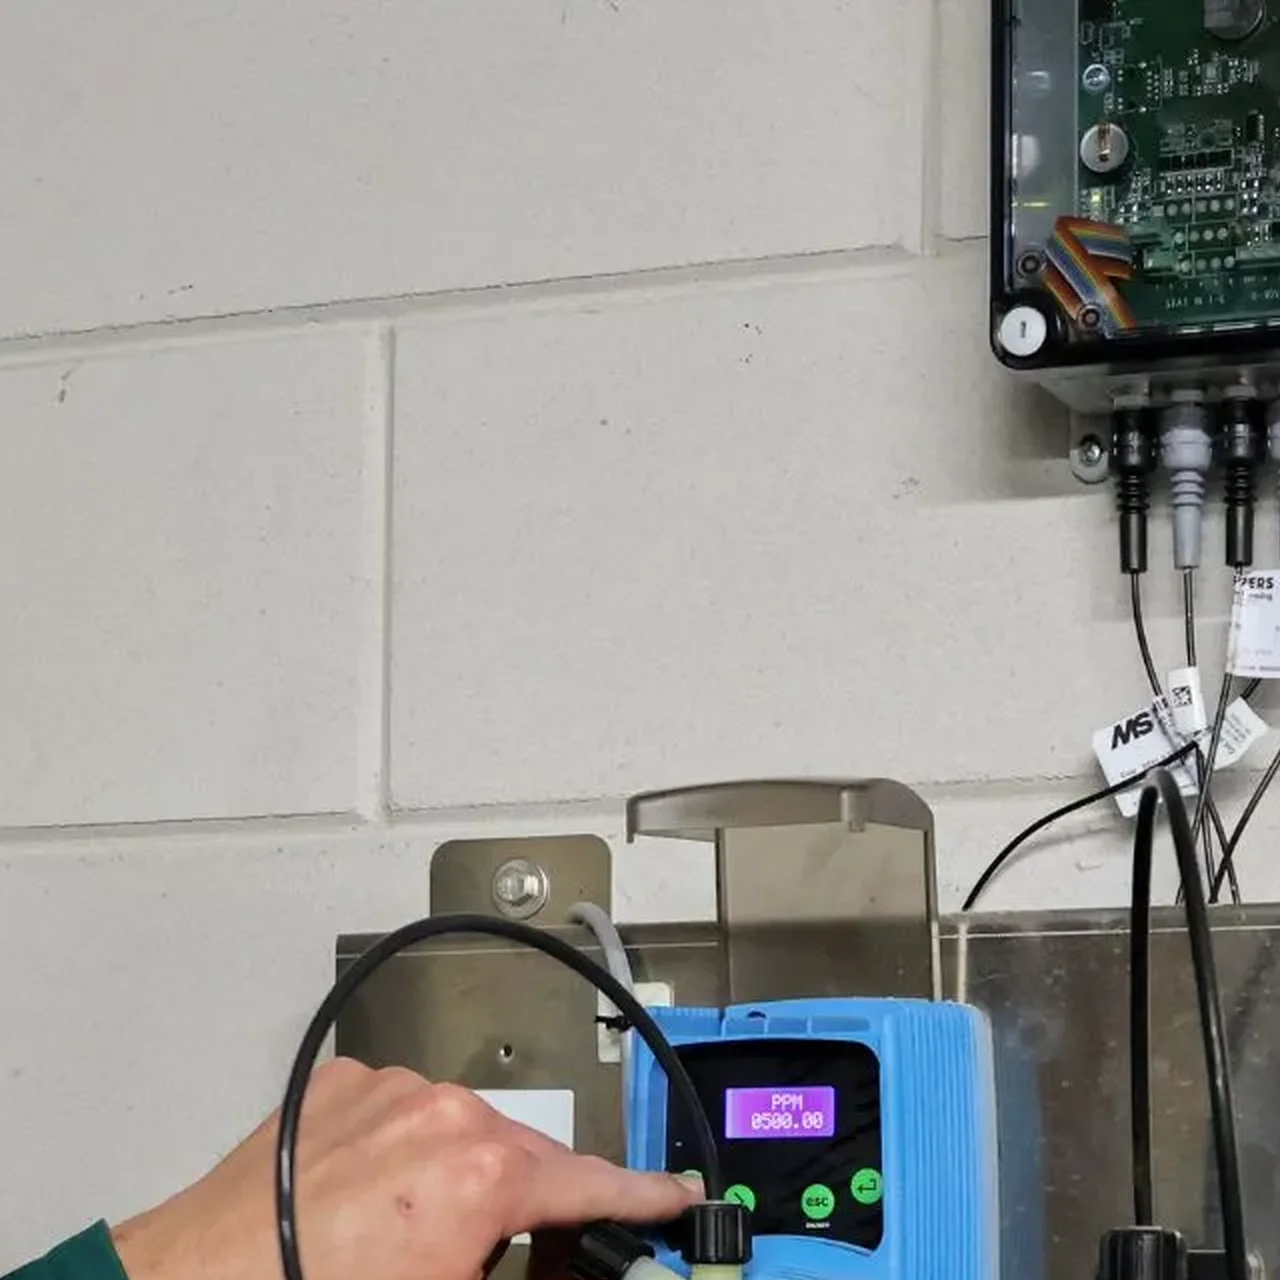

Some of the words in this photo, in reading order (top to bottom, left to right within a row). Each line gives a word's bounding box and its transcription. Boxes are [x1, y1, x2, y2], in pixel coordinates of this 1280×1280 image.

[771, 1094, 803, 1111] PPM
[751, 1112, 823, 1130] 0500.00
[806, 1196, 829, 1207] esc
